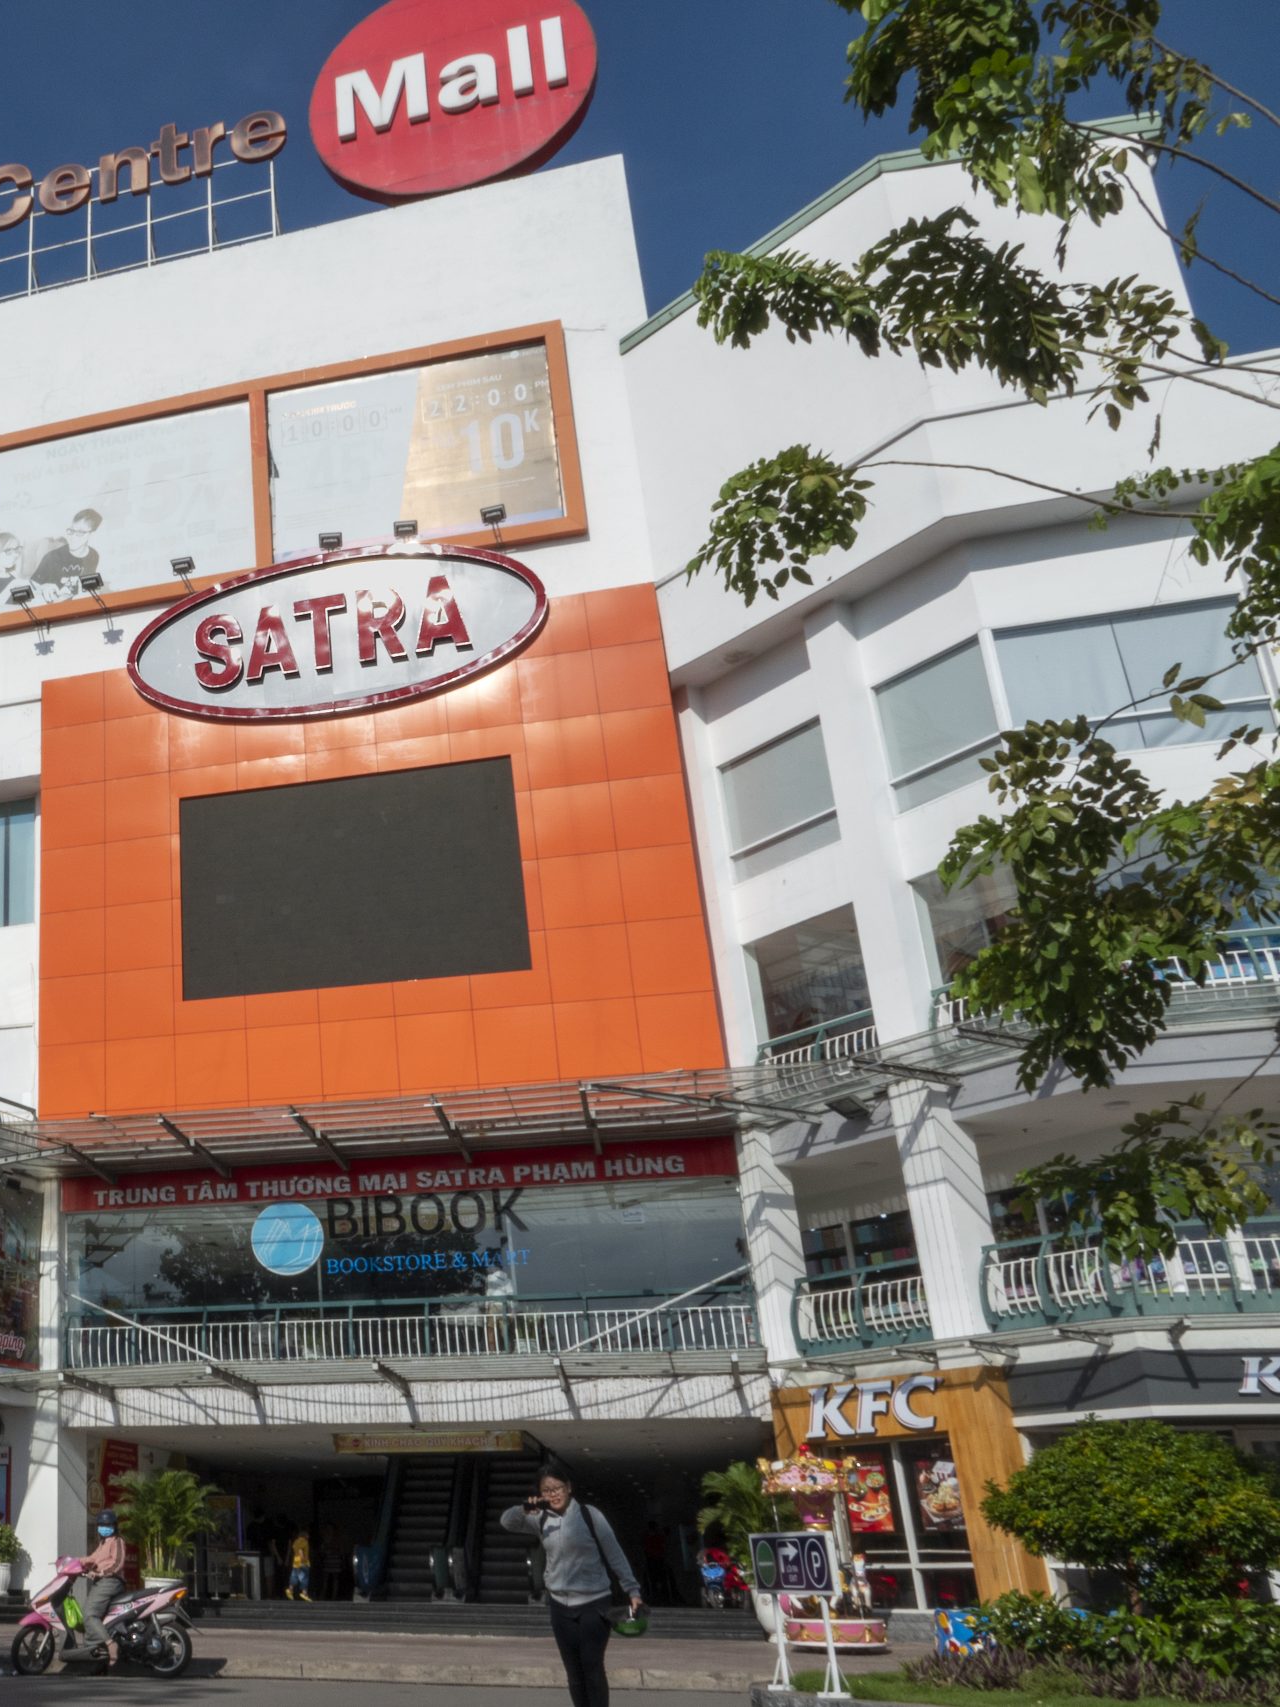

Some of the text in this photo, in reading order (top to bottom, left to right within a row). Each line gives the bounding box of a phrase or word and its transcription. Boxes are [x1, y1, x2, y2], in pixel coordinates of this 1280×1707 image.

[335, 14, 568, 142] Mall
[194, 574, 474, 690] SATRA
[93, 1149, 685, 1208] TRUNG TÂM THƯƠNG MẠI SATRA PHẠM HÙNG
[326, 1188, 530, 1241] BIBOOK
[326, 1247, 531, 1276] BOOKSTORE & MART
[807, 1375, 938, 1440] KFC
[811, 1551, 821, 1578] P
